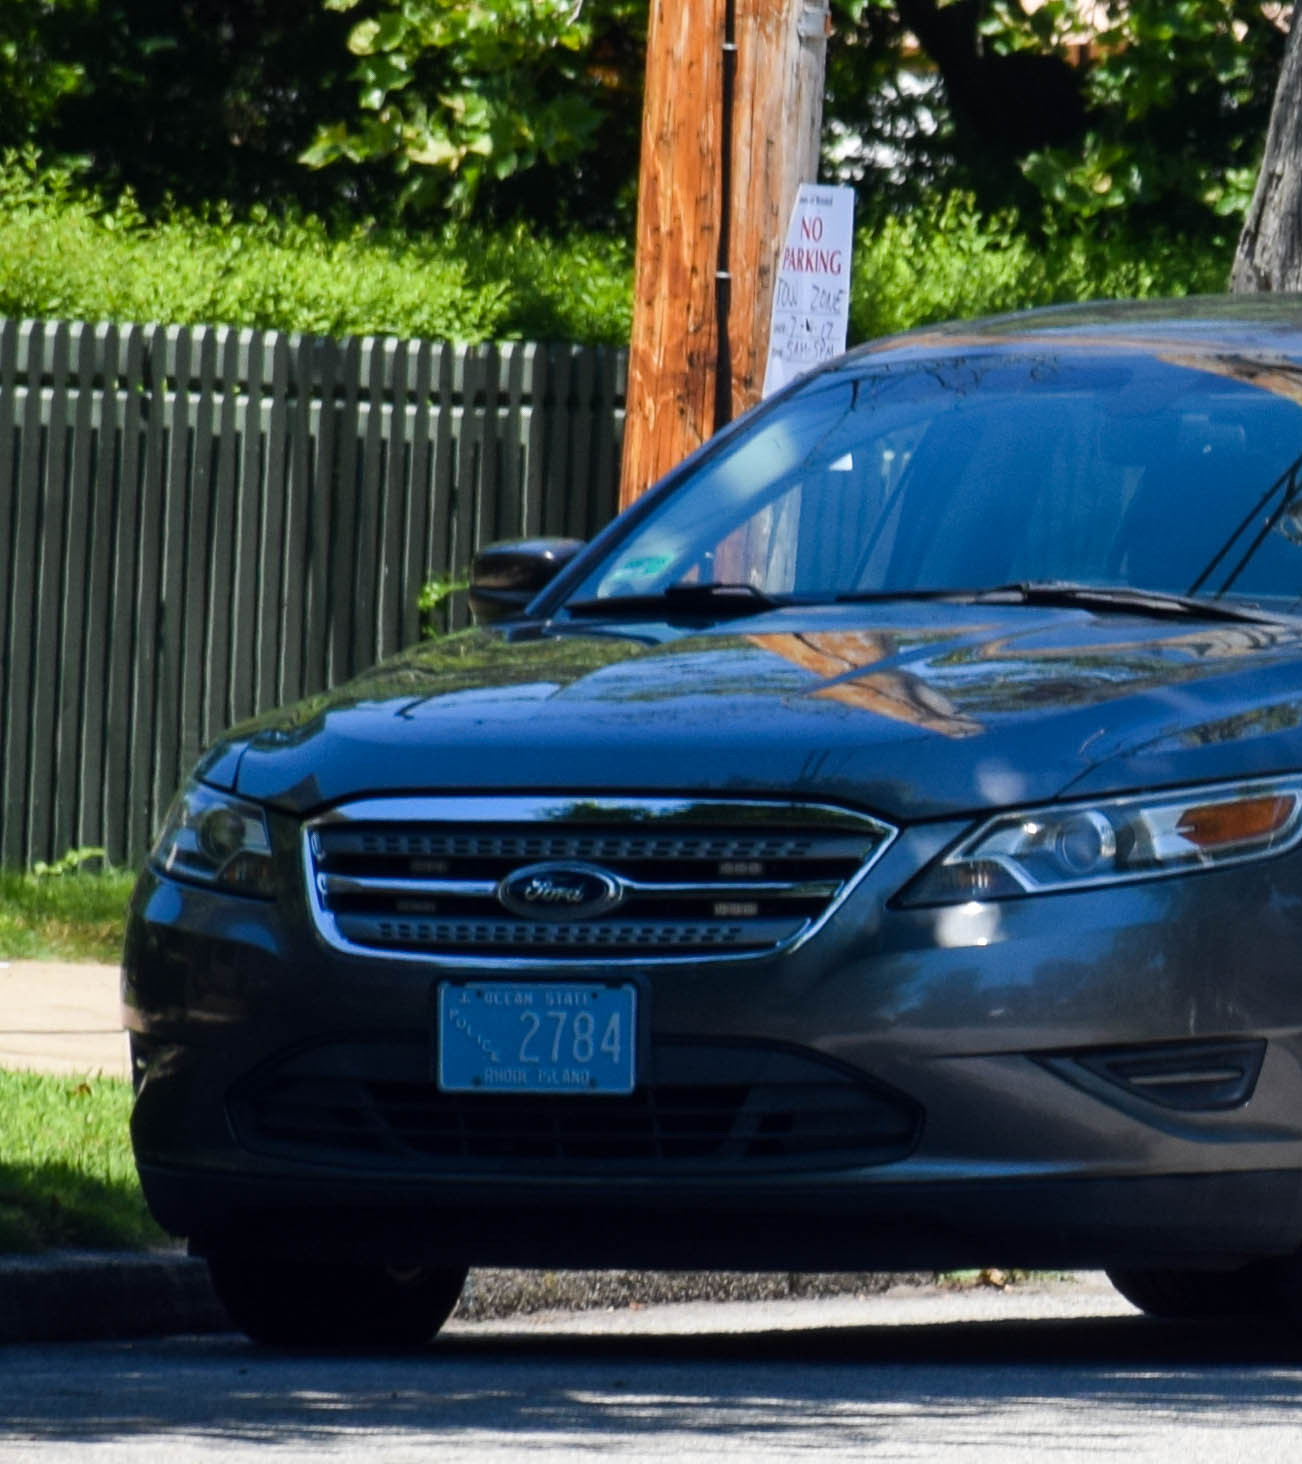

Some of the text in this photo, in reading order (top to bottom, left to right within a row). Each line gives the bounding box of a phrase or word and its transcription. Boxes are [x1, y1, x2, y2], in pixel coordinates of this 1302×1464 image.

[801, 216, 823, 242] NO
[783, 248, 842, 276] PARKING
[777, 277, 846, 313] TOW ZONE
[525, 879, 583, 902] Ford
[484, 991, 589, 1007] OCEAN STATE
[449, 1008, 500, 1063] POLICE
[519, 1010, 621, 1064] 2784
[484, 1068, 590, 1084] RHODE ISLAND
